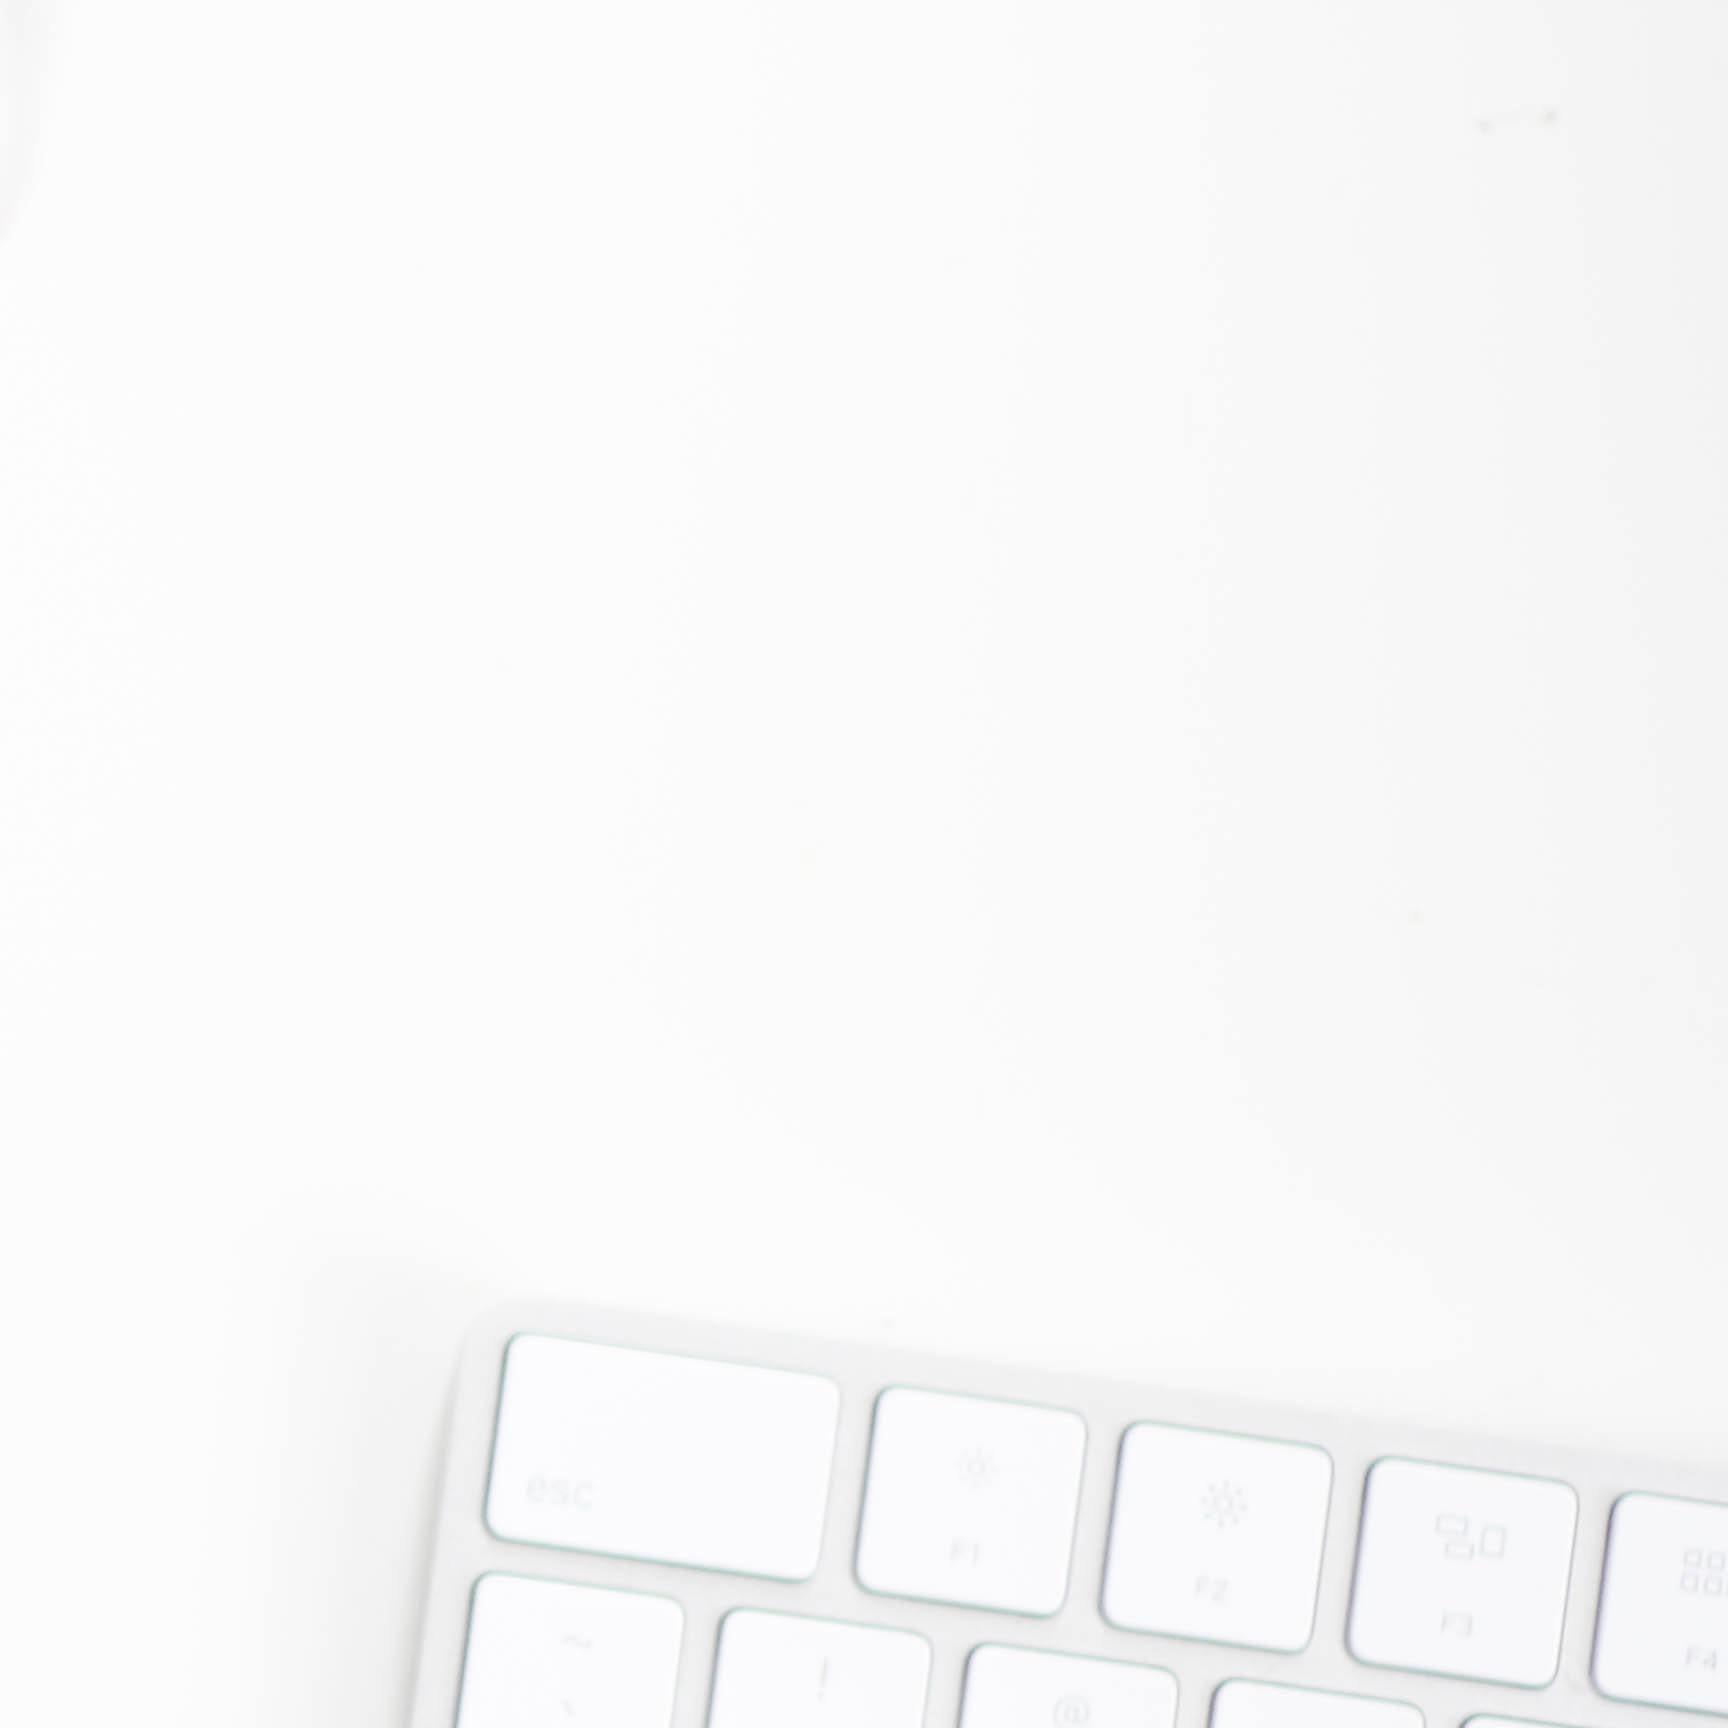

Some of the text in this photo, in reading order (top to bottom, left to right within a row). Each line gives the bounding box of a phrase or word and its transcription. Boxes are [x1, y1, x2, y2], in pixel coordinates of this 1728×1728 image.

[524, 1474, 597, 1510] esc
[1195, 1576, 1231, 1603] F2
[1440, 1611, 1474, 1637] F3
[1685, 1643, 1719, 1673] F4
